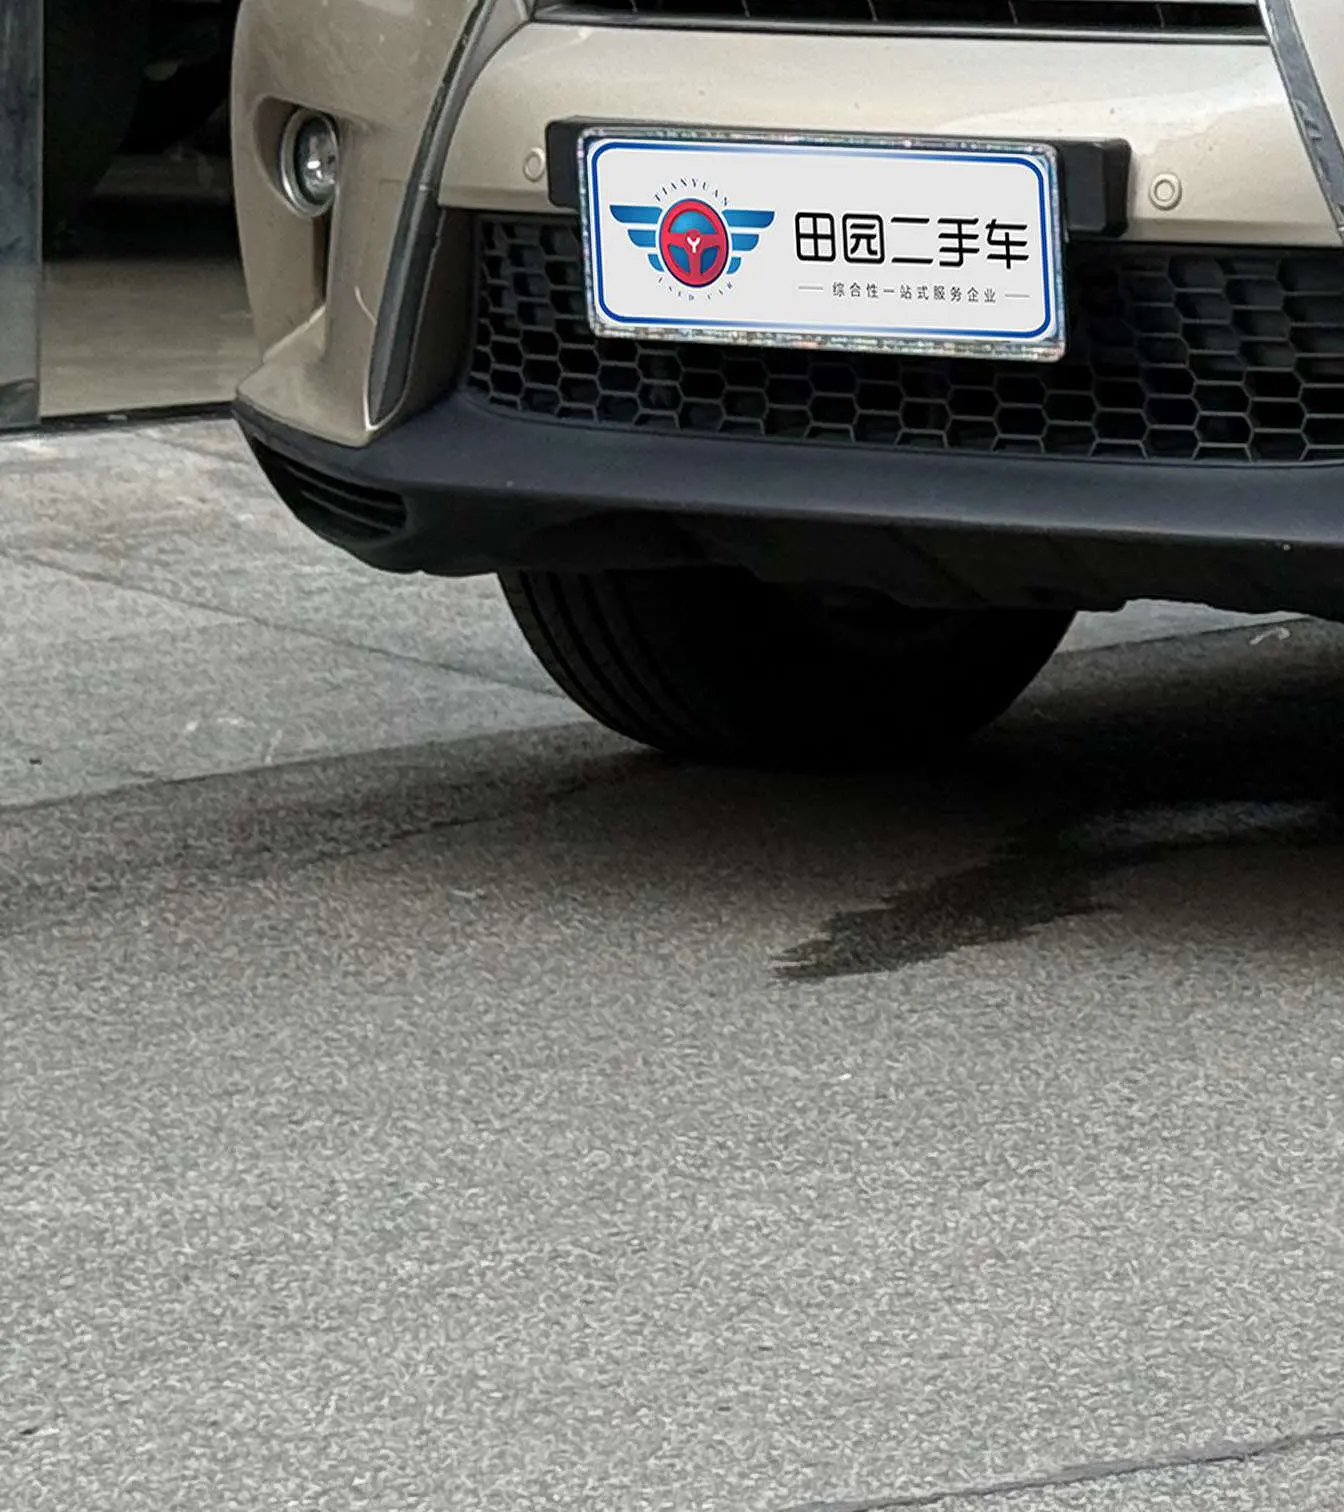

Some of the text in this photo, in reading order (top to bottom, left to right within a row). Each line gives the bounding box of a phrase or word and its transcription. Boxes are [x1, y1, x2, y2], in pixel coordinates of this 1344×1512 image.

[794, 211, 1030, 270] 田园二手车
[832, 280, 997, 303] 综合性一站式服务企业
